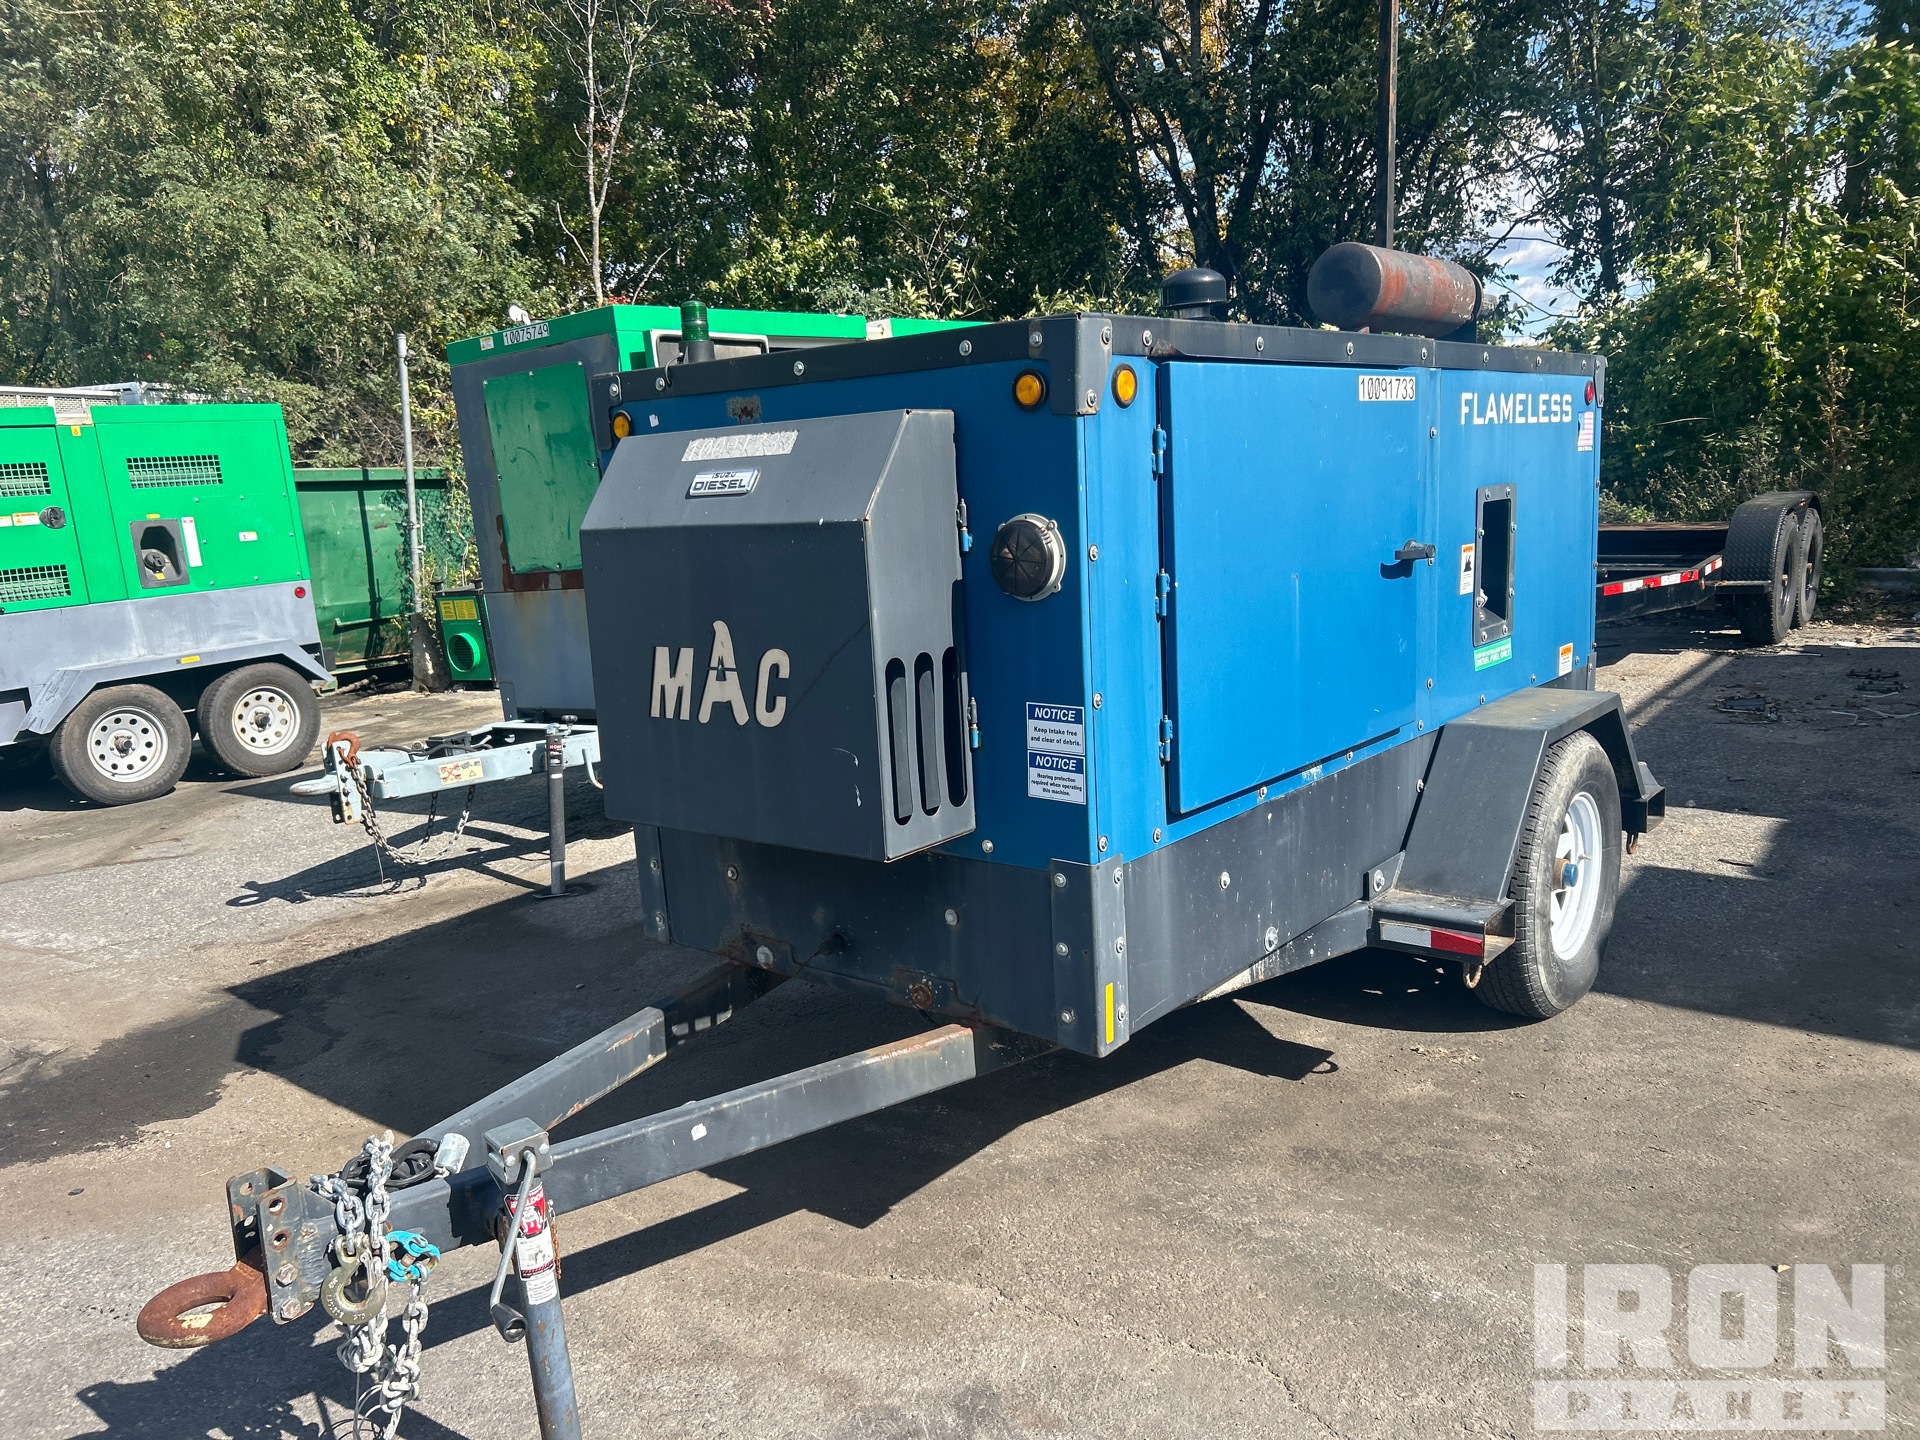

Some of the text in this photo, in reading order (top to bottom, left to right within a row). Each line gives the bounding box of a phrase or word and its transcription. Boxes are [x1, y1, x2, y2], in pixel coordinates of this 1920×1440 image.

[504, 323, 548, 345] 10075749
[1361, 377, 1415, 400] 10091733
[1460, 392, 1572, 425] FLAMELESS
[711, 471, 738, 479] ISUZU
[692, 479, 747, 491] DIESEL
[650, 620, 790, 728] MAC
[1034, 707, 1076, 721] NOTICE
[1033, 726, 1048, 734] Keep
[1035, 755, 1077, 770] NOTICE
[1037, 773, 1076, 783] Hearing protection
[1049, 780, 1061, 788] when
